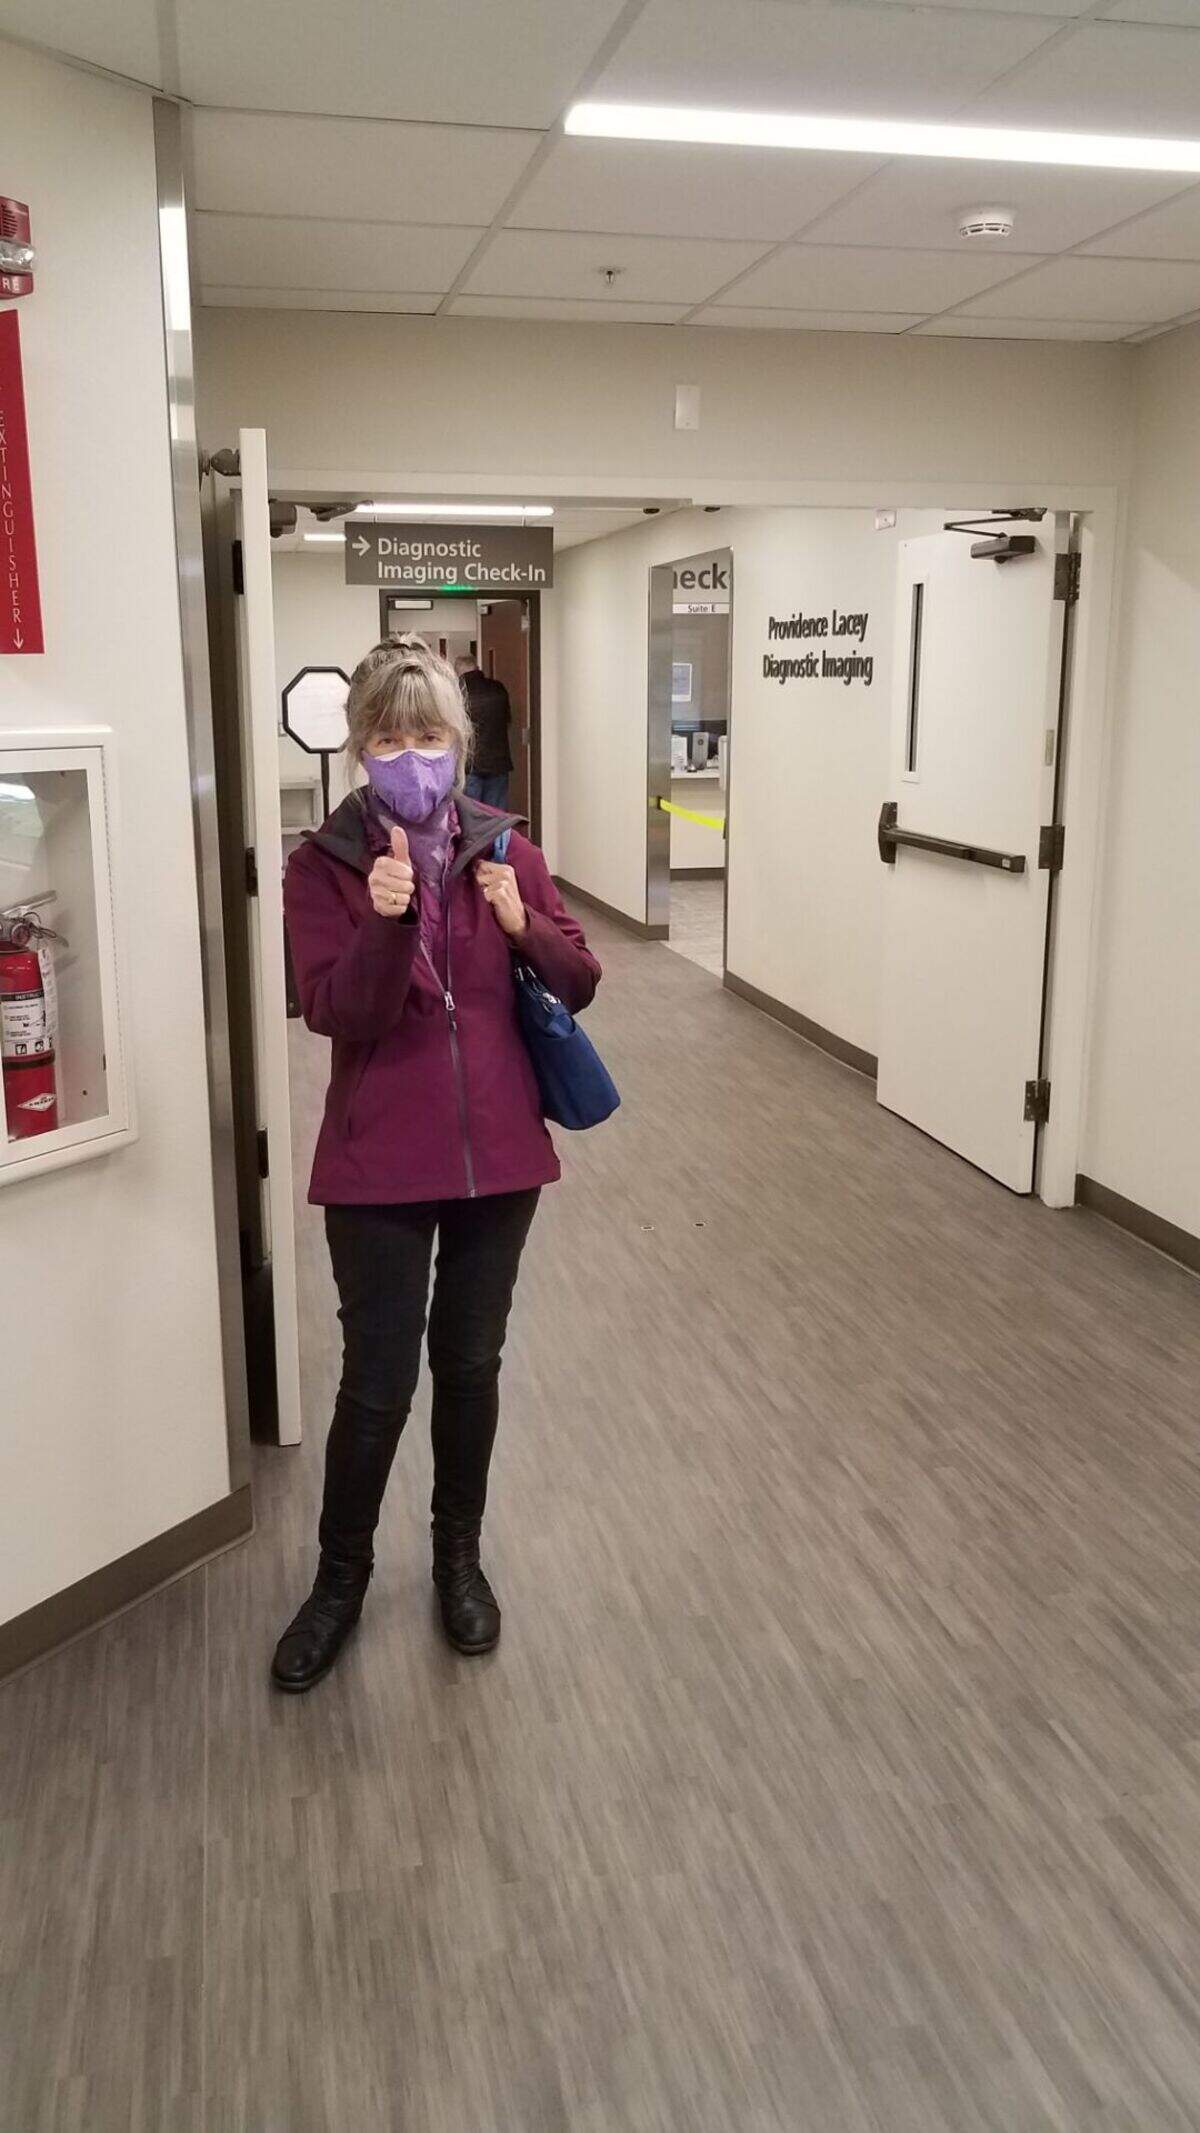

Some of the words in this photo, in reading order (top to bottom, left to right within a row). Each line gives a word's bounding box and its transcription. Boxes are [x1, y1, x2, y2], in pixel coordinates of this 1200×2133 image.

[377, 538, 482, 561] Diagnostic
[377, 561, 458, 583] Imaging
[464, 562, 546, 582] Check-In
[687, 604, 709, 613] Suite
[768, 612, 828, 640] Providence
[831, 609, 869, 642] Lacey
[763, 651, 819, 685] Diagnostic
[822, 649, 873, 686] Imaging
